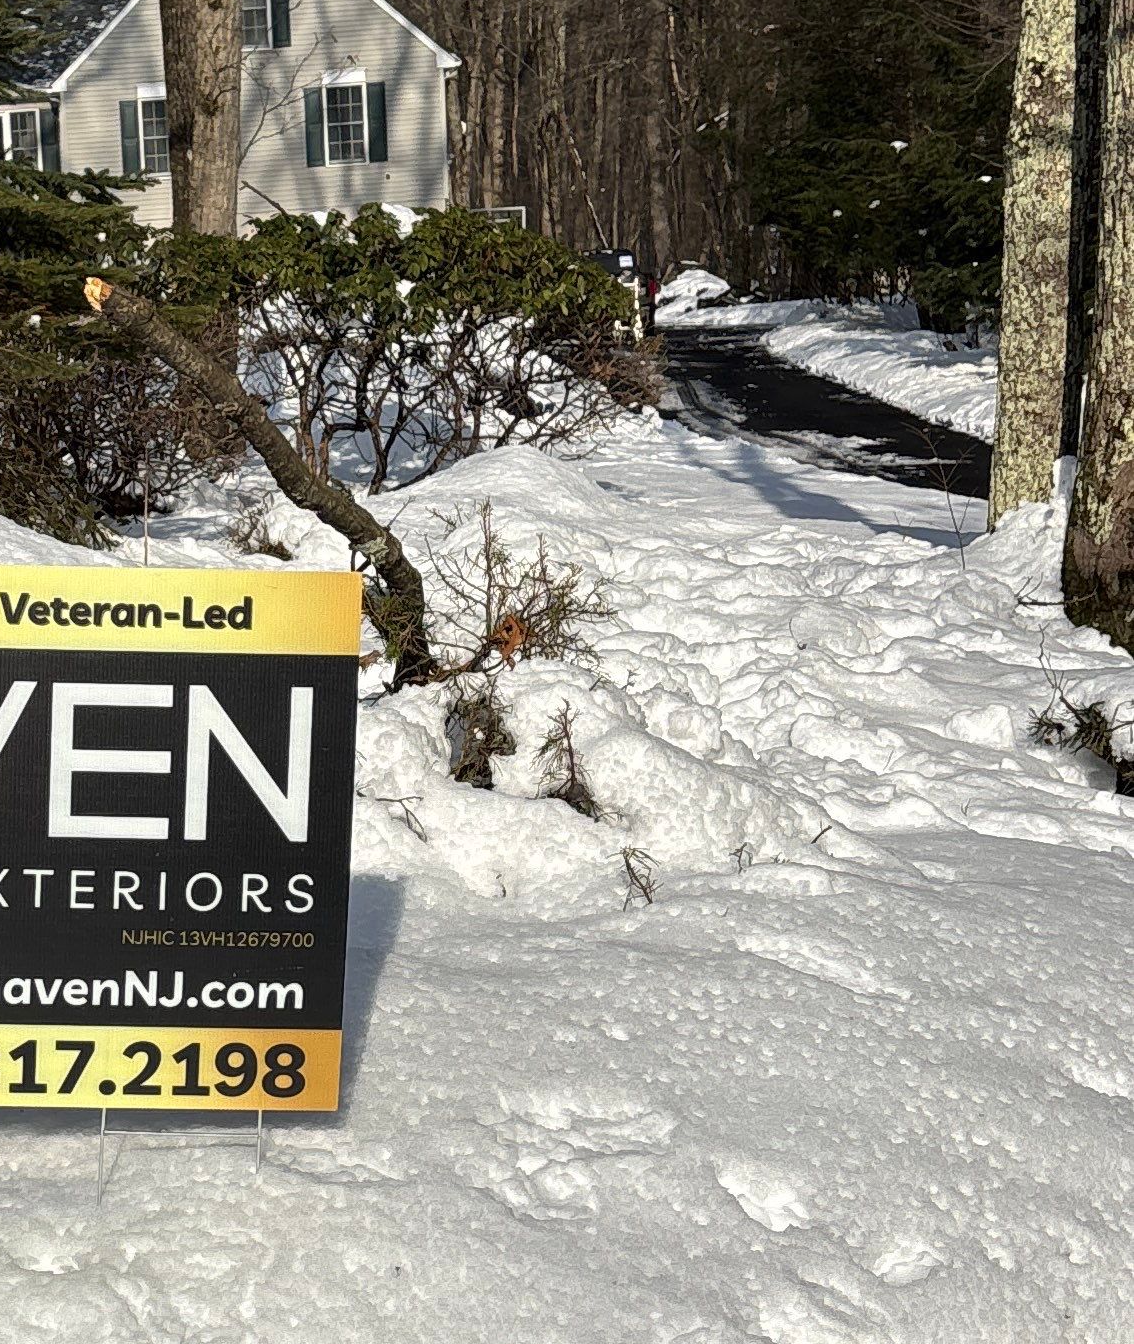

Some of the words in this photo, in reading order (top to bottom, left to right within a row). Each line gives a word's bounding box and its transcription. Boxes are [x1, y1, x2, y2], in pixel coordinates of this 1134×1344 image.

[0, 593, 252, 630] Veteran-Led
[121, 928, 174, 947] NJHIC
[179, 929, 315, 949] 13VH12679700
